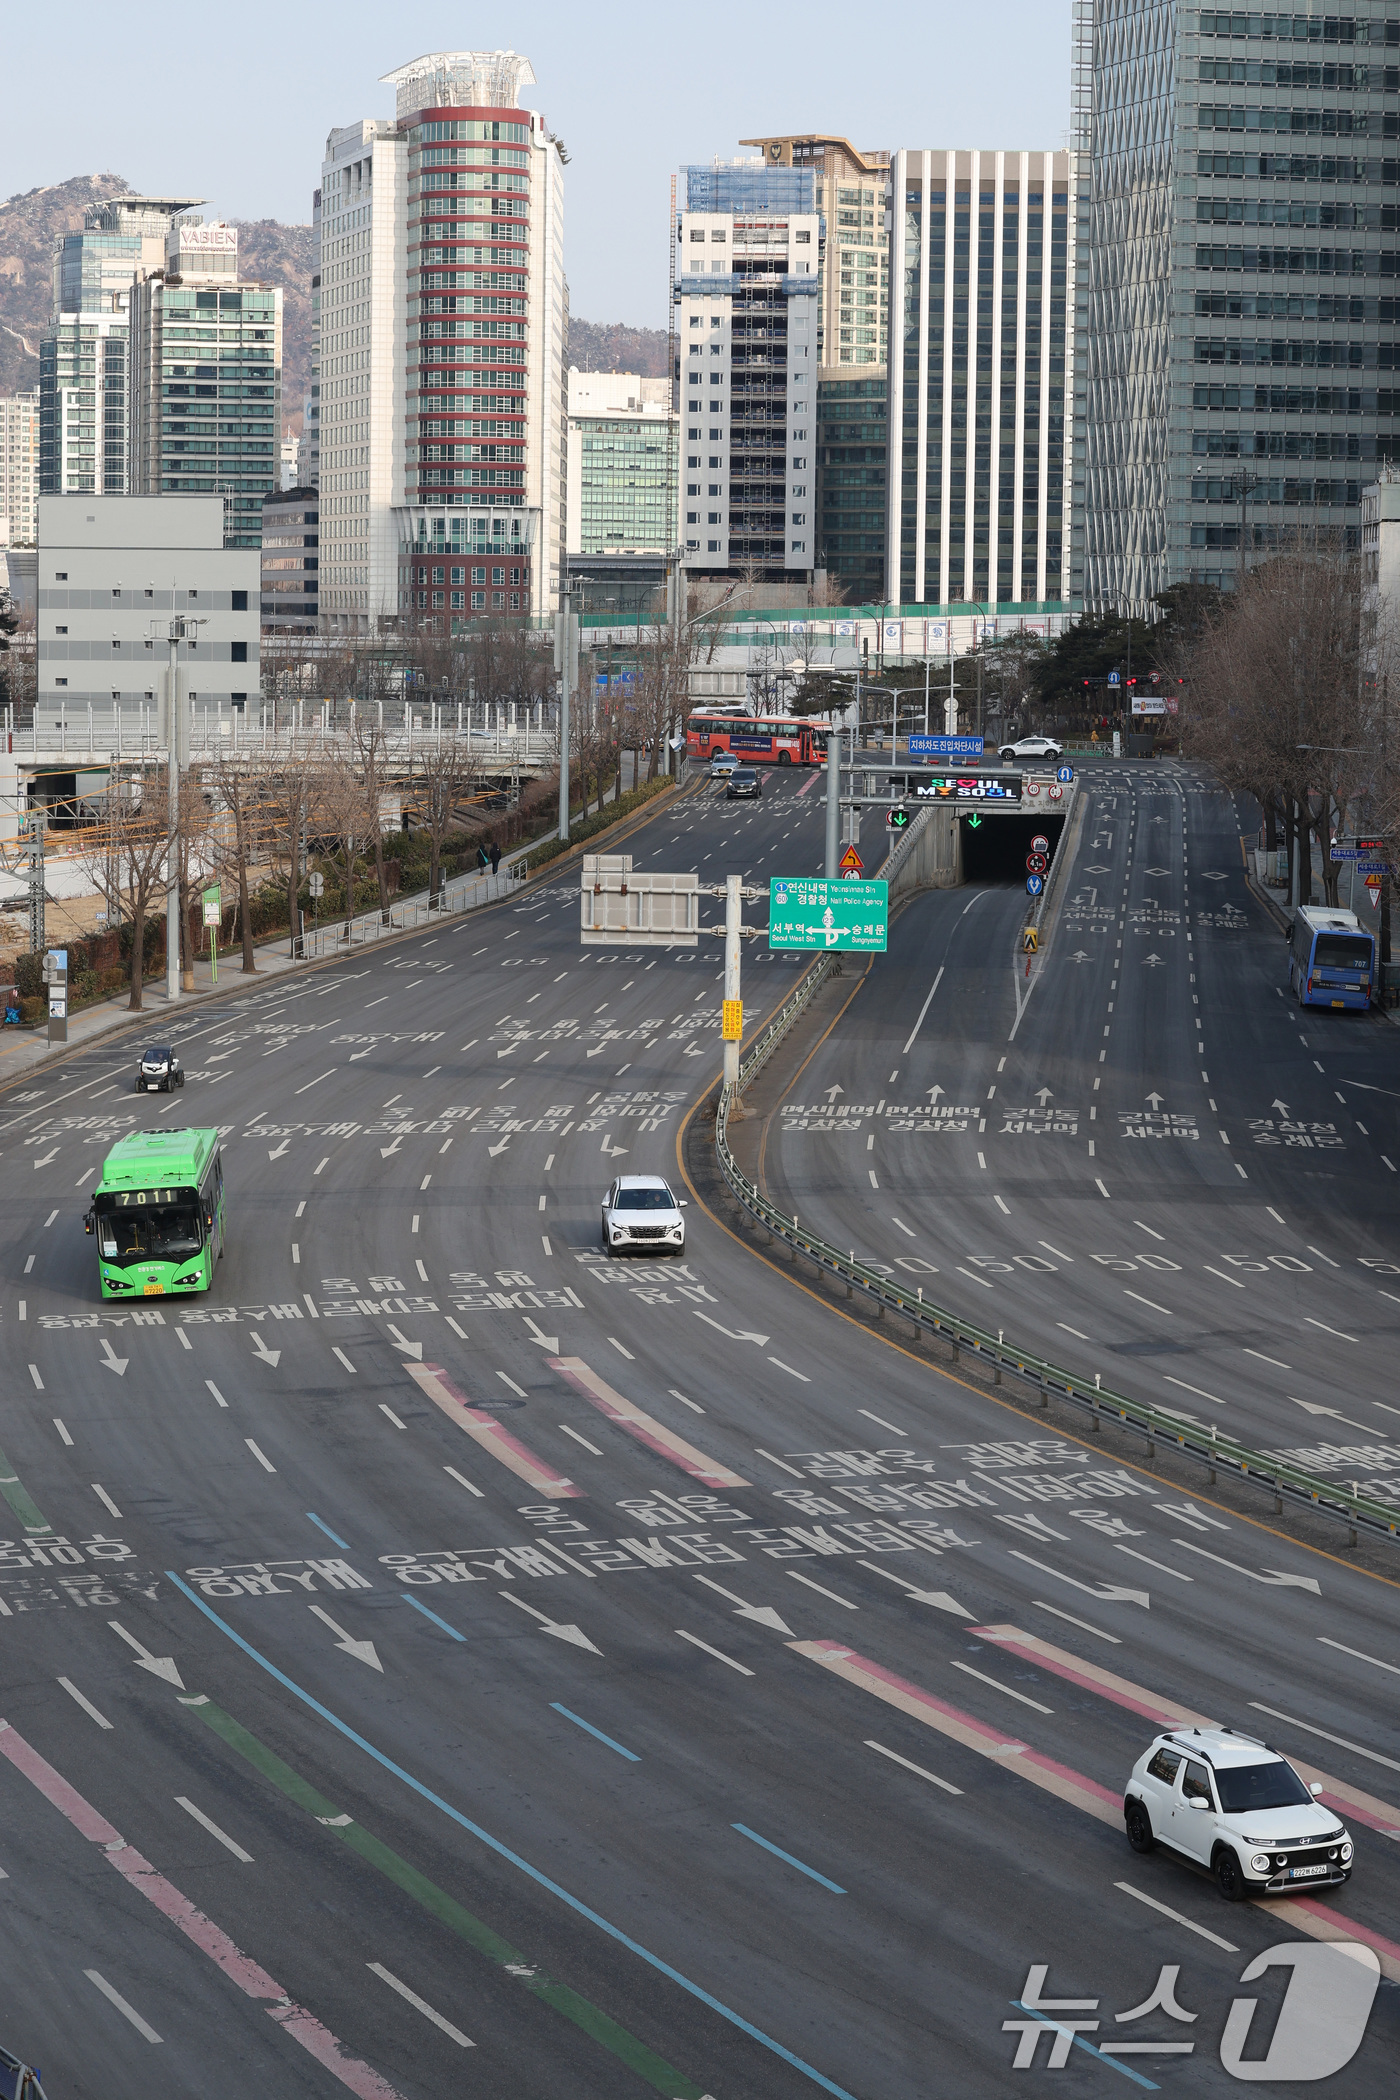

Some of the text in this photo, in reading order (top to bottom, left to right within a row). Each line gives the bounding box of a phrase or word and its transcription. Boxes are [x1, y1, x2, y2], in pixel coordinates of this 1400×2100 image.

[181, 231, 236, 244] VABIEN
[910, 739, 982, 753] 지하차도진입차단시설
[787, 882, 828, 893] 연신내역
[797, 894, 828, 905] 경찰청
[772, 922, 805, 934] 서부역
[851, 924, 885, 936] 숭례문
[1065, 924, 1108, 933] 50
[1133, 927, 1176, 937] 50
[394, 960, 447, 969] 50
[500, 957, 551, 967] 50
[595, 954, 645, 963] 50
[674, 954, 722, 962] 50
[754, 953, 801, 962] 50
[1354, 960, 1367, 968] 707
[328, 1031, 446, 1044] 버스전용
[486, 1029, 568, 1041] 퇴계로
[575, 1029, 655, 1040] 퇴계로
[603, 1091, 689, 1103] 숭례문
[589, 1103, 680, 1117] 시의회
[780, 1104, 876, 1118] 연신내역
[884, 1105, 981, 1119] 연신내역
[1002, 1107, 1080, 1121] 공덕동
[45, 1115, 141, 1130] 후암동
[469, 1118, 564, 1133] 퇴계로
[780, 1118, 862, 1132] 경찰청
[887, 1118, 969, 1132] 경찰청
[1117, 1111, 1197, 1126] 공덕동
[1244, 1118, 1337, 1134] 경찰청
[241, 1121, 358, 1138] 버스전용
[362, 1120, 457, 1134] 퇴계로
[998, 1121, 1079, 1136] 서부역
[1120, 1125, 1200, 1140] 서부역
[1252, 1132, 1348, 1149] 숭례문
[120, 1189, 172, 1206] 7011
[965, 1254, 1059, 1273] 50
[1088, 1253, 1183, 1272] 50
[1220, 1253, 1314, 1273] 50
[586, 1264, 700, 1284] 시의회
[449, 1291, 575, 1311] 퇴계로
[629, 1286, 720, 1305] 시청
[179, 1304, 305, 1324] 버스전용
[319, 1296, 441, 1317] 퇴계로
[36, 1310, 167, 1329] 버스전용
[939, 1440, 1091, 1469] 숭례문
[784, 1450, 937, 1479] 숭례문
[998, 1470, 1161, 1502] 시의회
[829, 1480, 1000, 1513] 시의회
[731, 1522, 916, 1559] 퇴계로
[563, 1533, 748, 1572] 퇴계로
[377, 1546, 569, 1585] 버스전용
[185, 1558, 374, 1597] 버스전용
